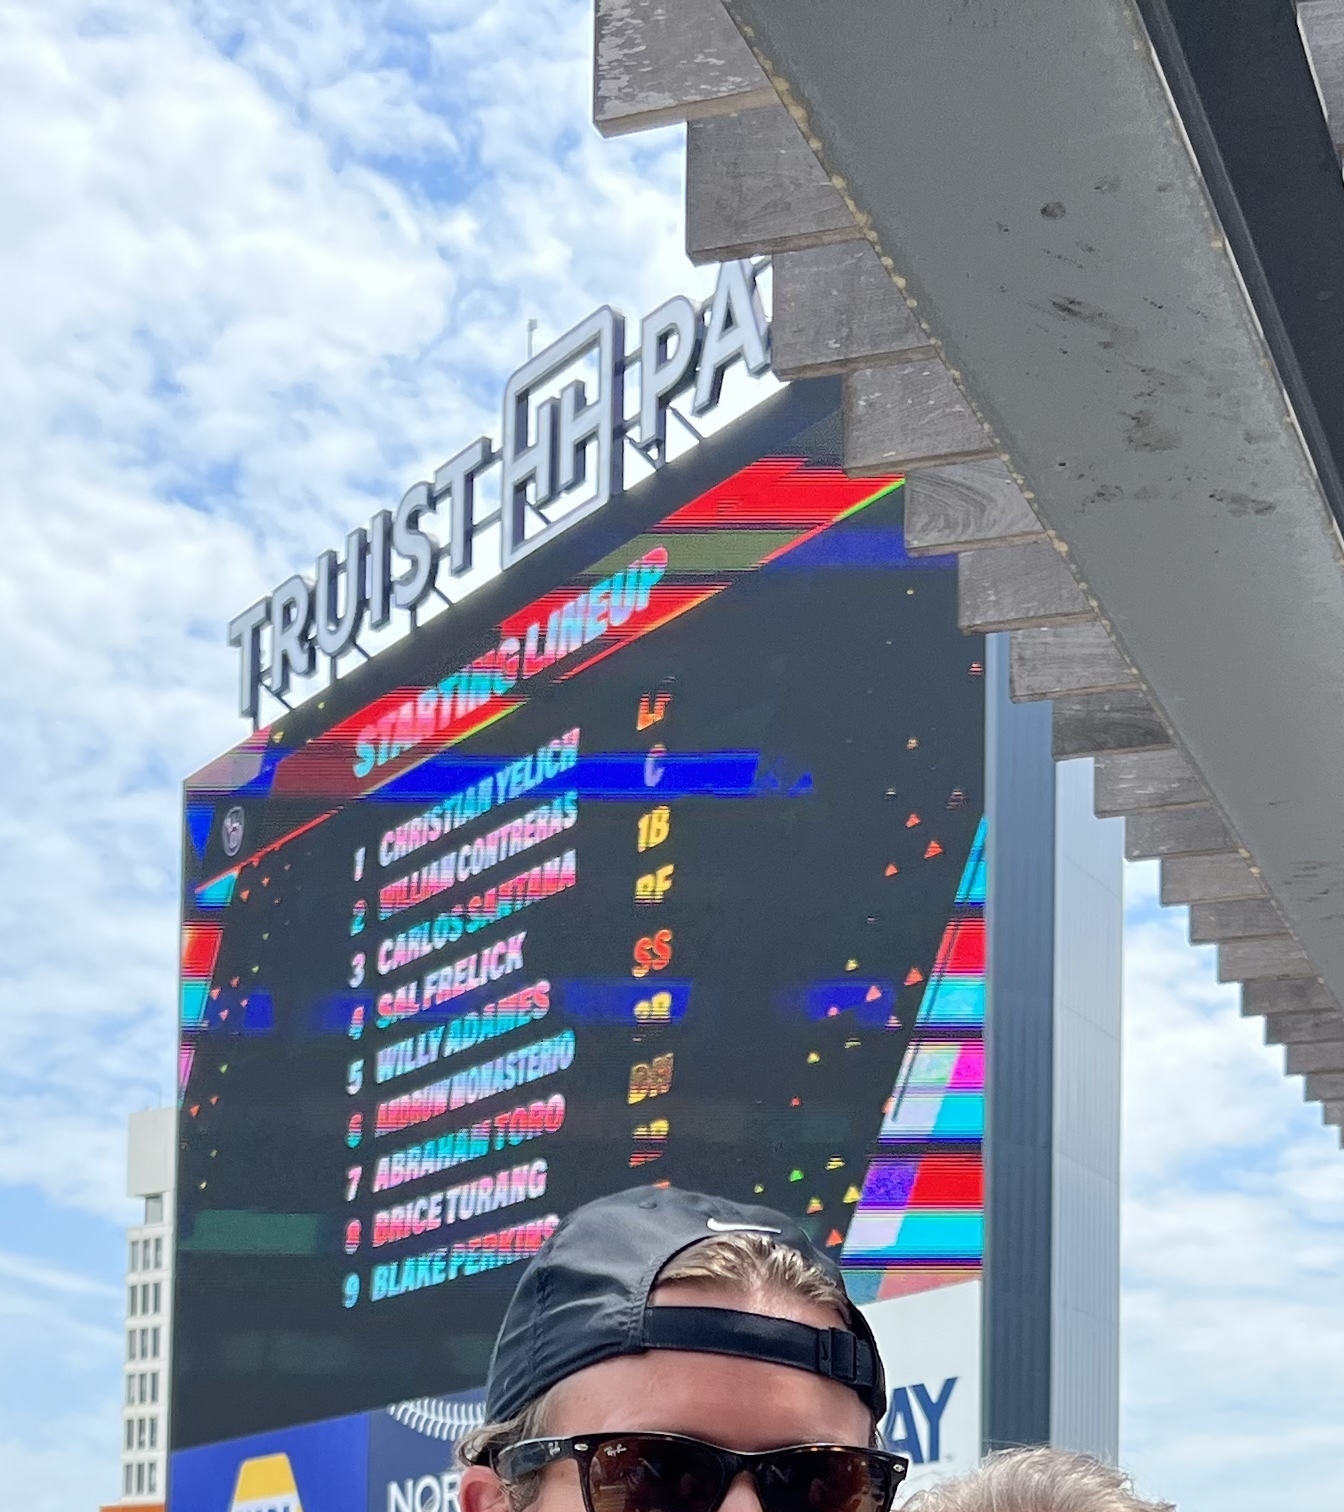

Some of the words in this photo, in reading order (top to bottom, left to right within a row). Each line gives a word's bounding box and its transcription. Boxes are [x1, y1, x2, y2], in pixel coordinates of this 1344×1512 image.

[227, 436, 491, 719] TRUIST
[354, 638, 522, 778] STARTING
[522, 547, 669, 679] LINEUP
[354, 846, 366, 882] 1
[378, 776, 494, 867] CHRISTIAN
[495, 728, 580, 806] YELICH
[637, 805, 671, 854] 1B
[349, 952, 365, 988] 3
[377, 903, 465, 975] CARLOS
[465, 849, 577, 933] SANTANA
[350, 900, 367, 936] 2
[457, 791, 578, 882] CONTRERAS
[376, 980, 420, 1029] SAL
[421, 931, 528, 1011] FRELICK
[632, 929, 673, 977] SS
[346, 1058, 364, 1096] 5
[376, 1025, 446, 1085] WILLY
[442, 979, 551, 1058] ADAMES
[347, 1166, 363, 1202] 7
[372, 1120, 491, 1193] ABRAHAM
[494, 1093, 567, 1151] TORO
[372, 1193, 444, 1248] BRICE
[445, 1157, 548, 1225] TURANG
[343, 1272, 361, 1309] 9
[371, 1247, 448, 1302] BLAKE
